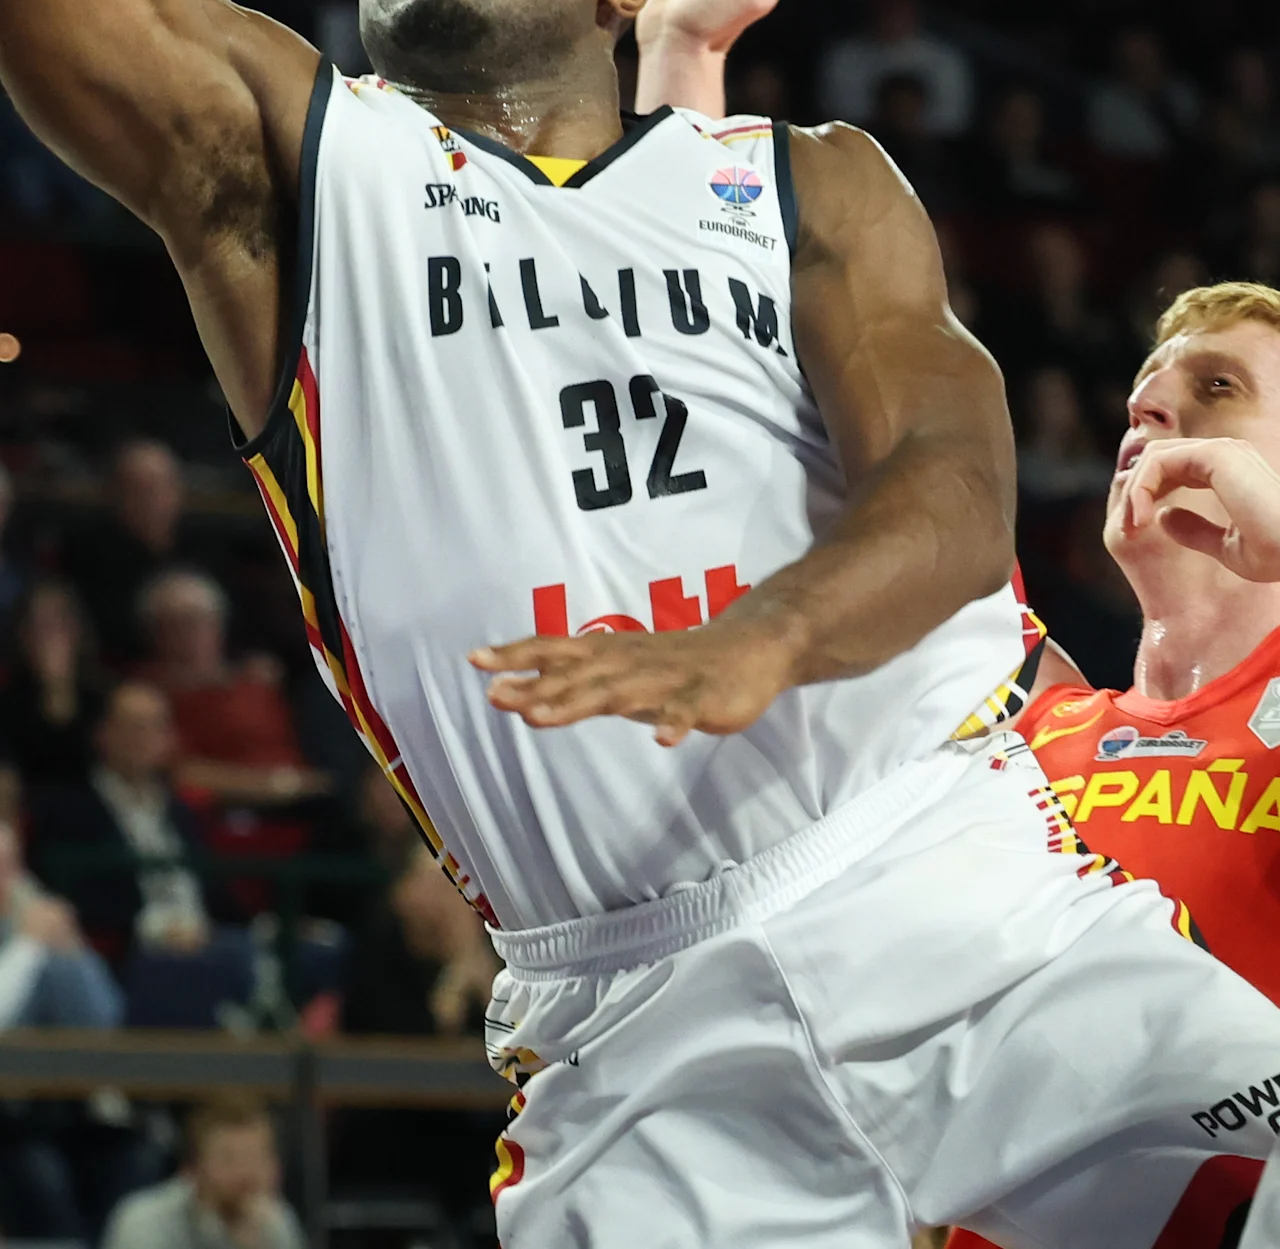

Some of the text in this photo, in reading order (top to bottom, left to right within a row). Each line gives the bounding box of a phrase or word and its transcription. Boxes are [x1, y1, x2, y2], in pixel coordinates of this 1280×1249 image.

[424, 183, 501, 223] SPAING
[699, 219, 777, 251] EUROBASKET
[559, 374, 708, 512] 32
